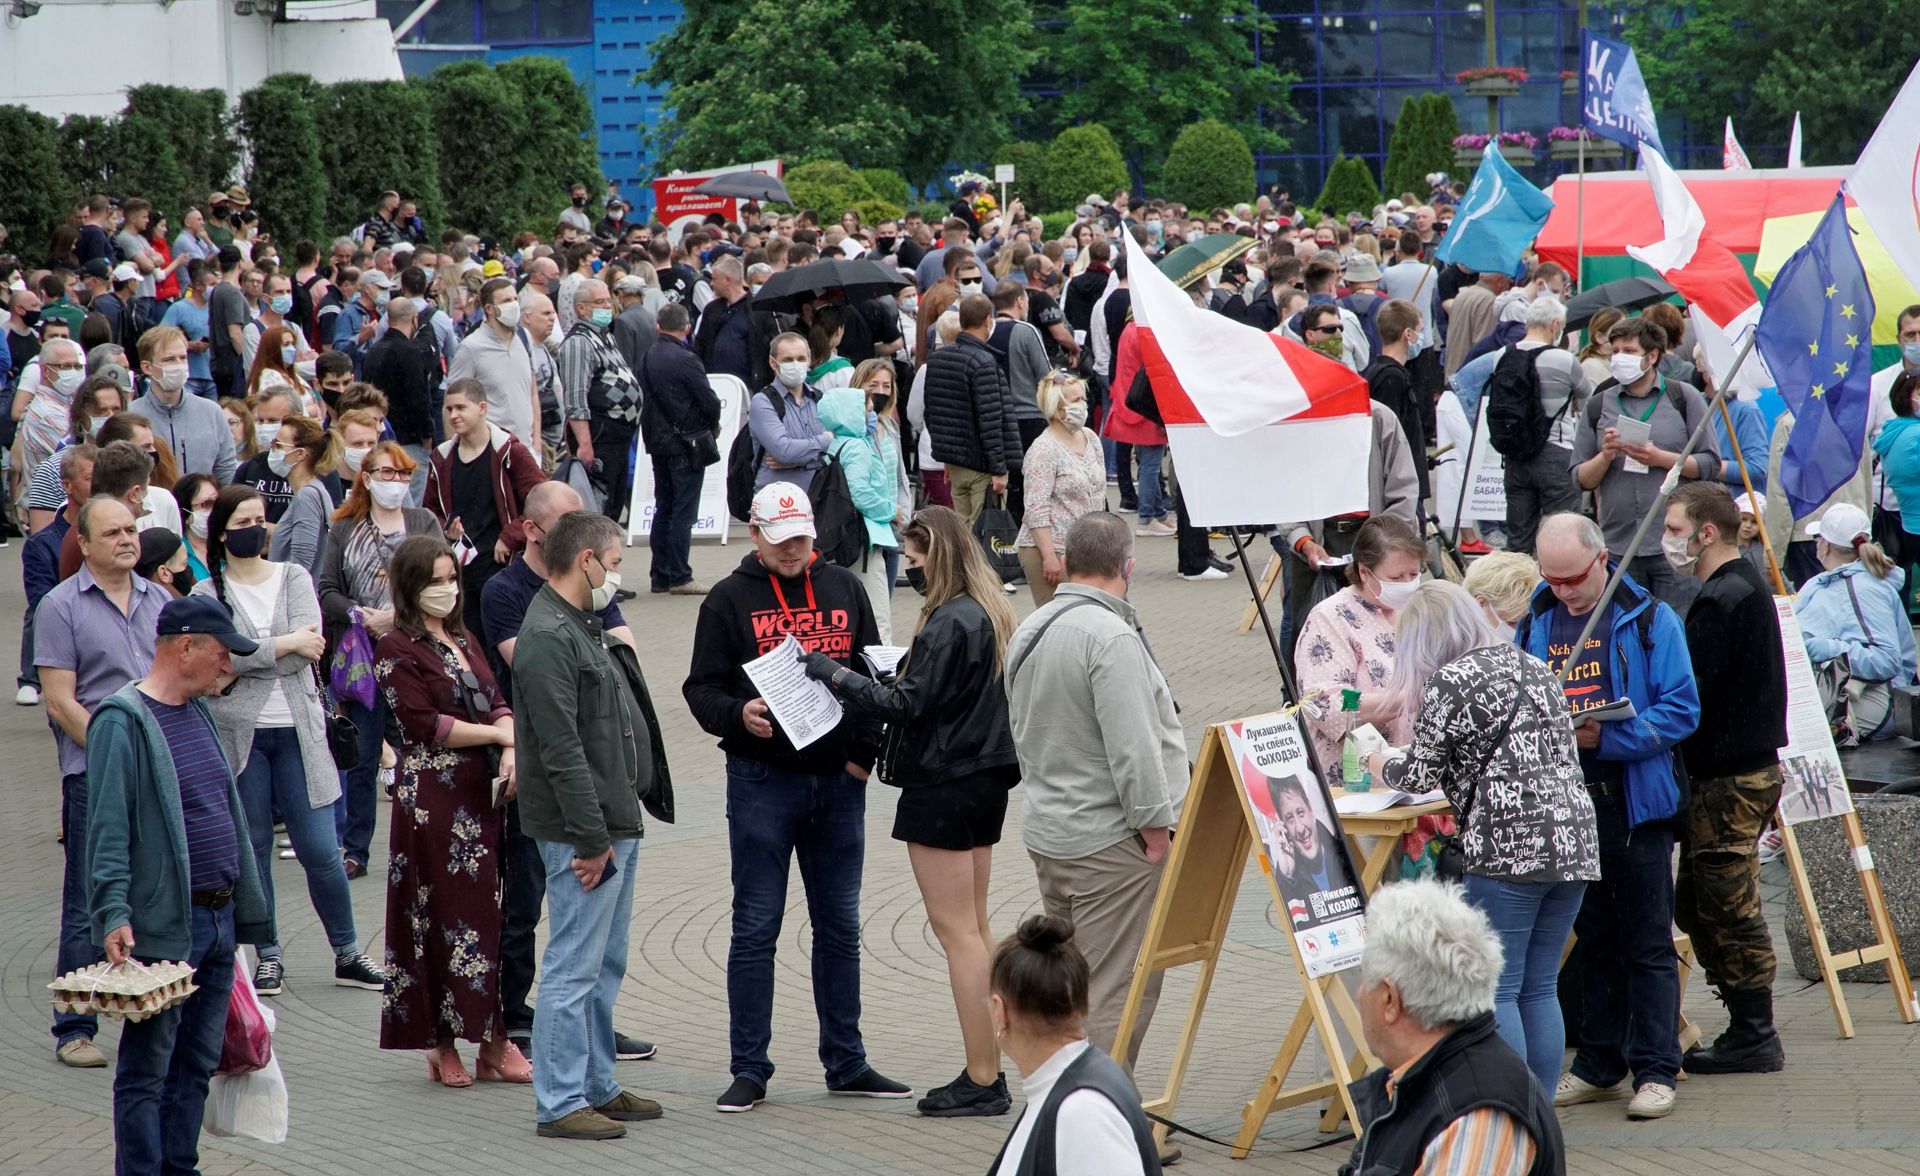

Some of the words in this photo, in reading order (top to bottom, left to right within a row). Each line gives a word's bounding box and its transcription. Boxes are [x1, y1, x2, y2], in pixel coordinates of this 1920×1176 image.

[751, 609, 849, 638] WORLD
[758, 635, 852, 656] CHMPION
[1584, 638, 1601, 649] den
[1246, 722, 1295, 741] Лукашэнка,
[1253, 742, 1266, 753] ты
[1266, 736, 1297, 750] спёкся,
[1256, 747, 1302, 767] СЫХОДЗЬ!
[1321, 885, 1356, 902] Никола
